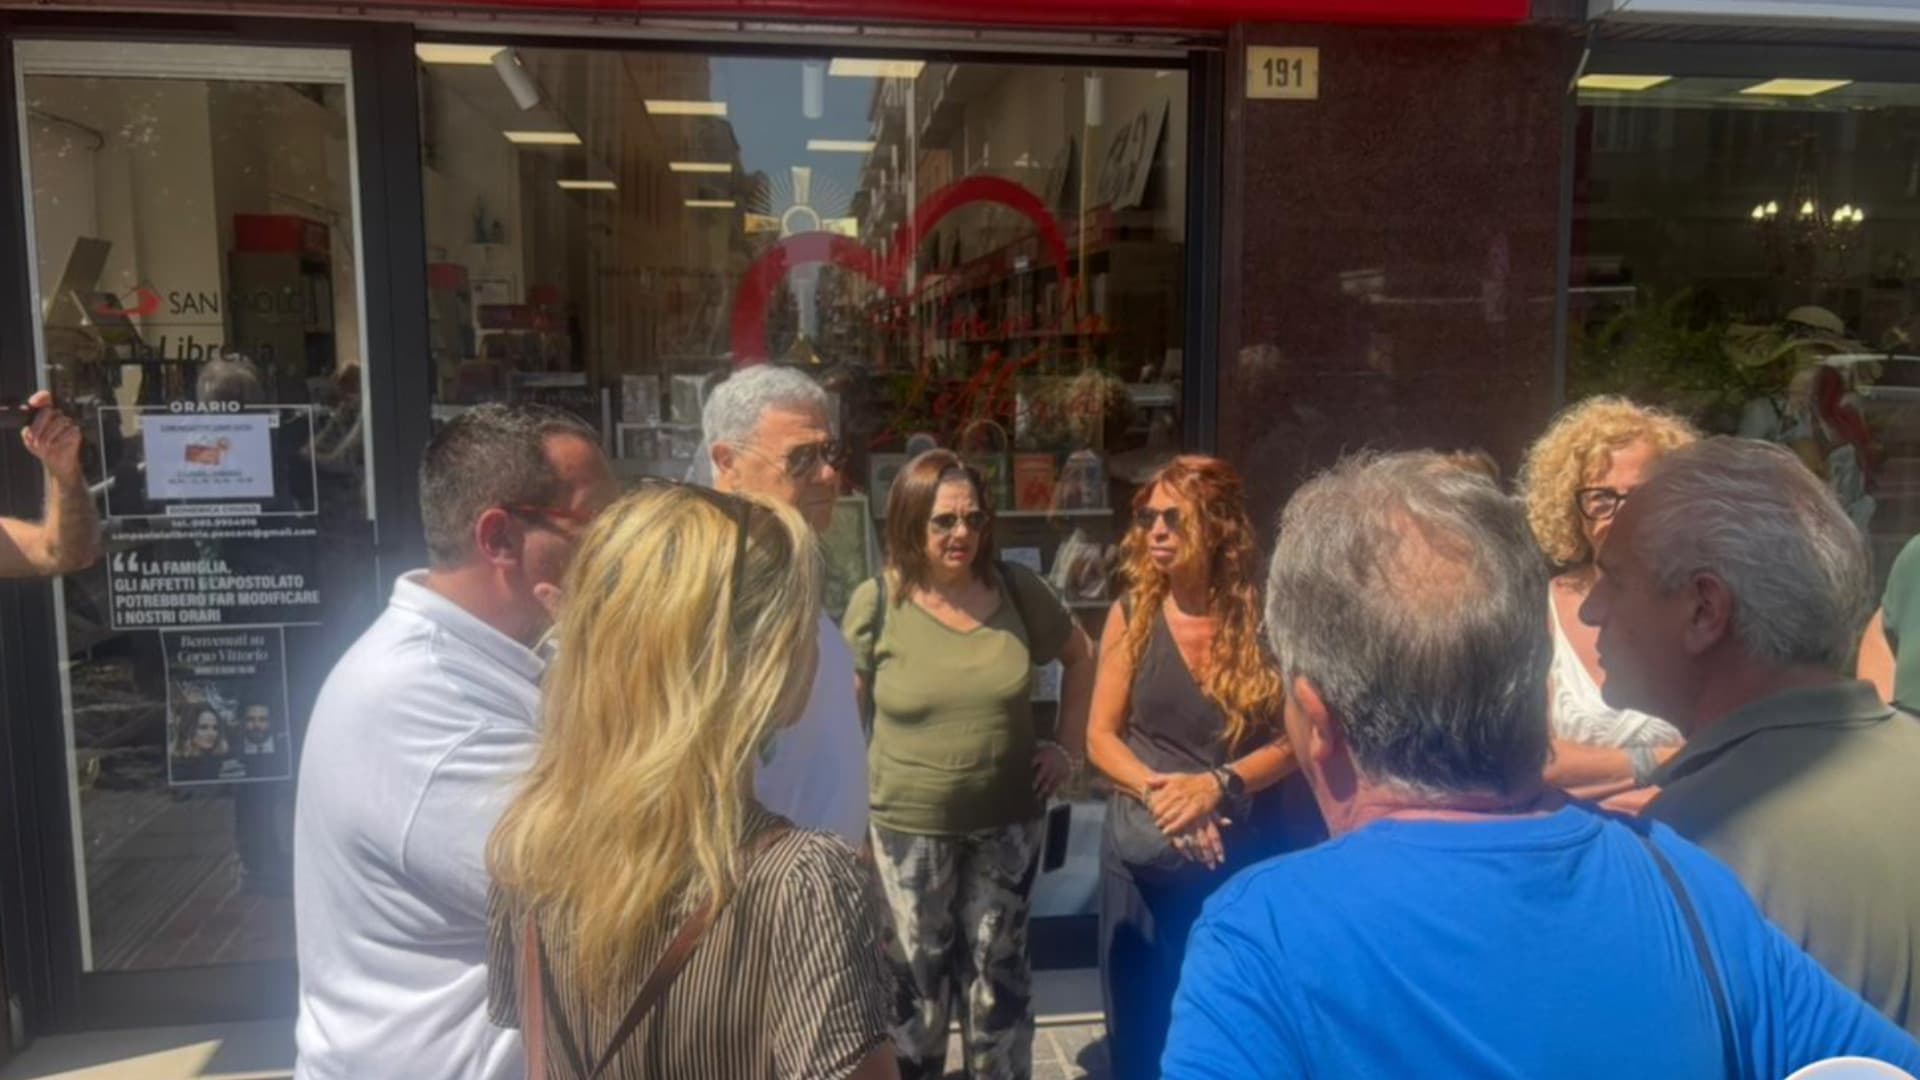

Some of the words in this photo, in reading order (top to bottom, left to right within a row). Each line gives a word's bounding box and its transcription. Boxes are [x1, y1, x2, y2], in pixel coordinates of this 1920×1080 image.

[1263, 57, 1303, 88] 191
[168, 291, 218, 315] SAN
[170, 401, 241, 413] ORARIO
[142, 561, 160, 575] LA
[115, 578, 138, 592] GLI
[140, 576, 195, 591] AFFETTI
[116, 593, 205, 607] POTREBBERO
[209, 592, 235, 606] FAR
[238, 590, 320, 605] MODIFICARE
[117, 611, 122, 624] I
[125, 610, 175, 624] NOSTRI
[179, 609, 221, 623] ORARI
[180, 632, 248, 648] Benvenuti
